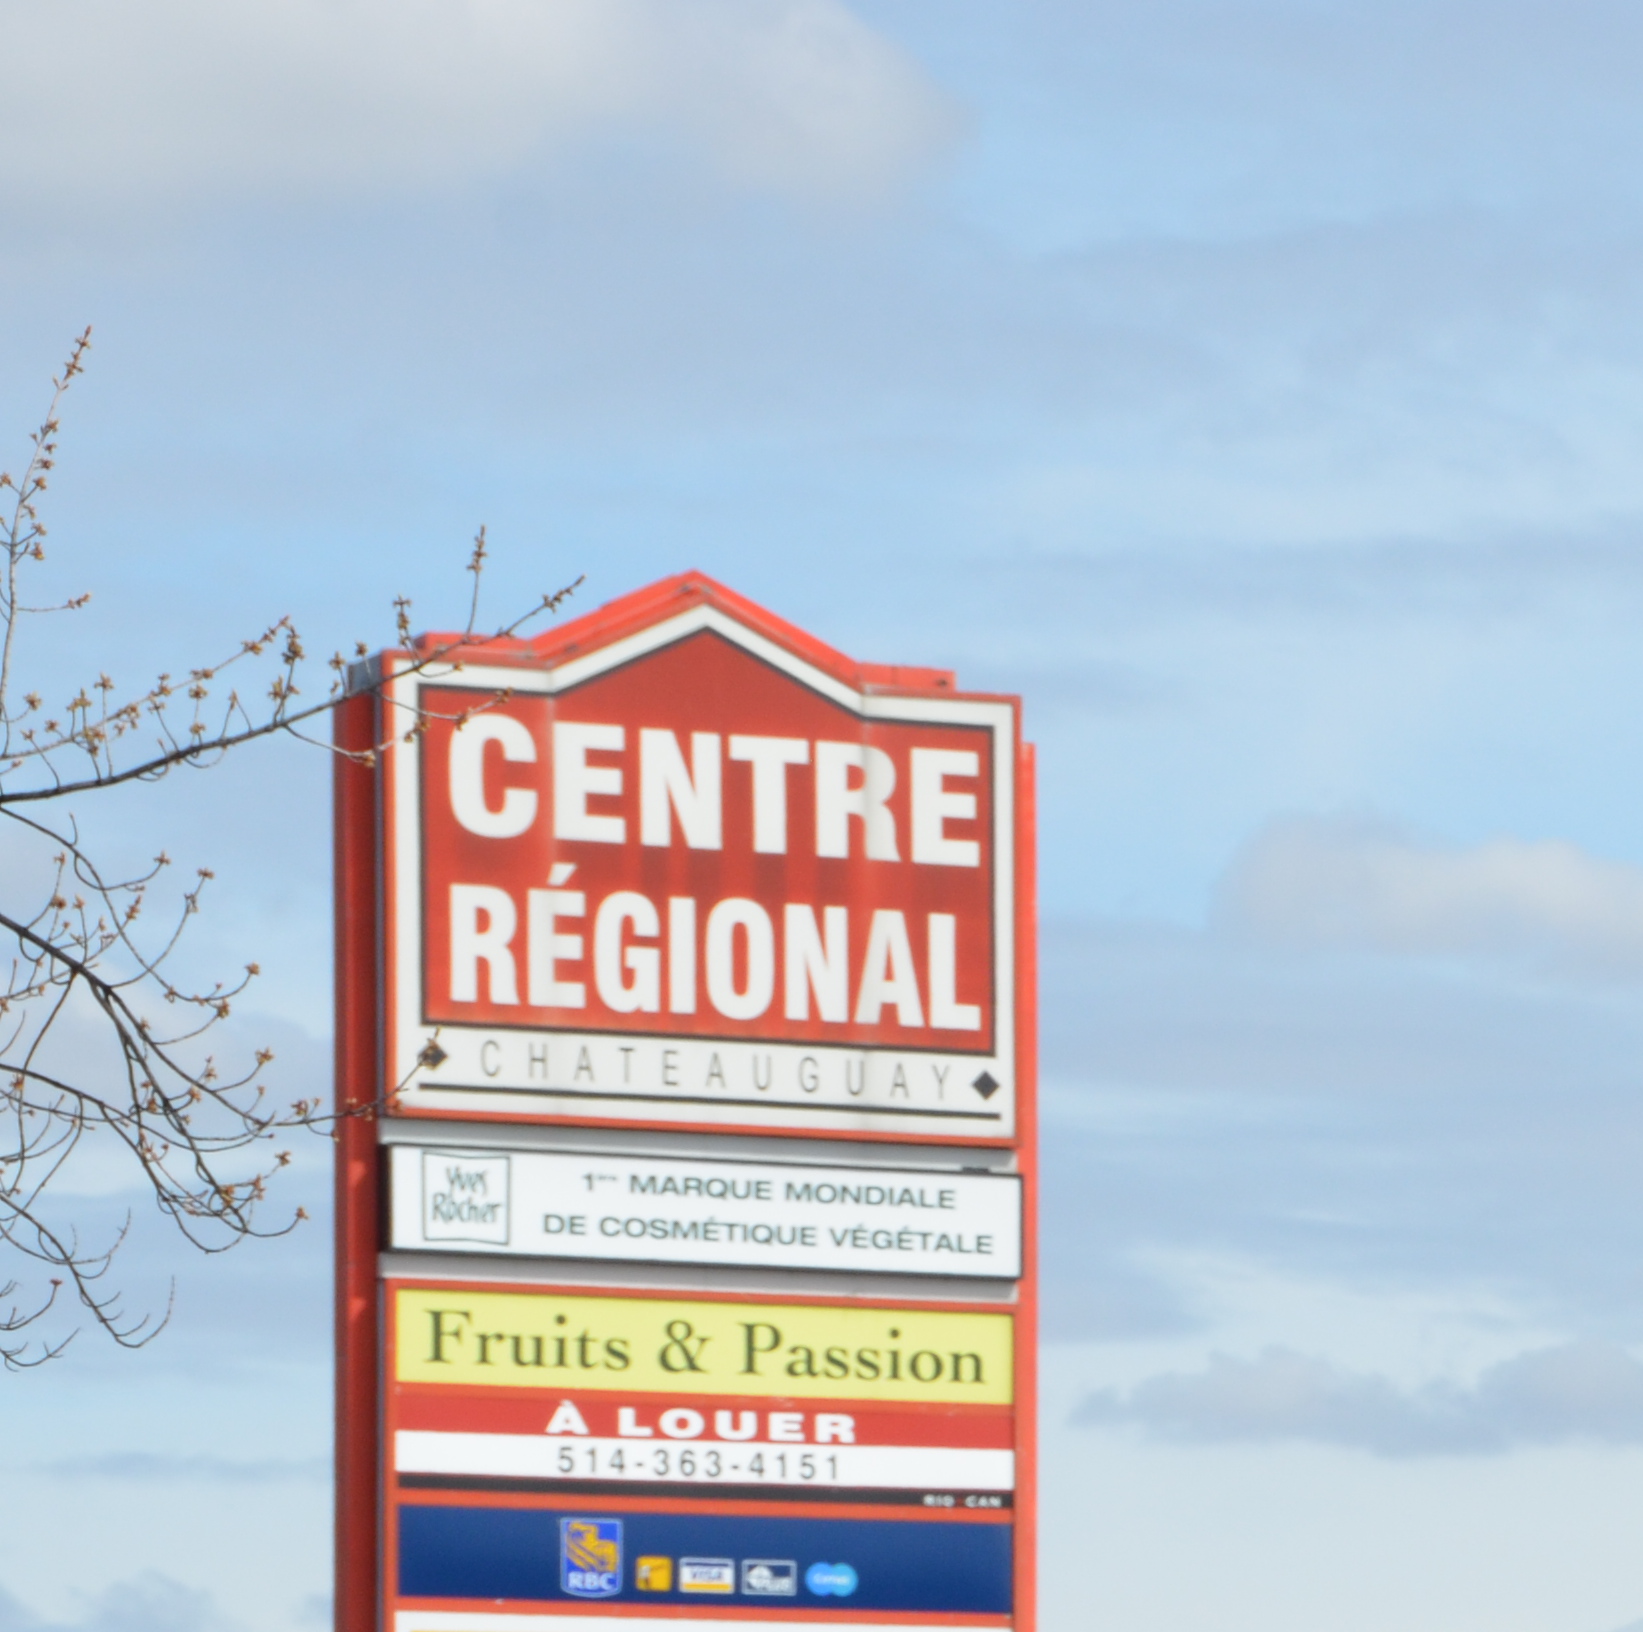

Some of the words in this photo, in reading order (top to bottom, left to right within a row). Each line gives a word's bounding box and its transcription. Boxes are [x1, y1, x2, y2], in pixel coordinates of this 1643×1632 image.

[448, 712, 981, 868] CENTRE
[448, 863, 982, 1031] RÉGIONAL
[479, 1039, 952, 1099] CHATEAUGUAY
[446, 1165, 488, 1195] Yves
[628, 1174, 772, 1201] MARQUE
[784, 1181, 956, 1210] MONDIALE
[431, 1192, 503, 1224] Rocher
[543, 1213, 587, 1236] DE
[598, 1216, 817, 1247] COSMÉTIQUE
[828, 1224, 994, 1255] VÉGÉTALE
[422, 1307, 631, 1372] Fruits
[658, 1318, 712, 1374] &
[736, 1320, 986, 1385] Passion
[545, 1399, 589, 1435] À
[617, 1406, 857, 1444] LOUER
[557, 1446, 841, 1481] 514-363-4151
[965, 1494, 1002, 1509] CAN
[567, 1571, 617, 1591] RBC
